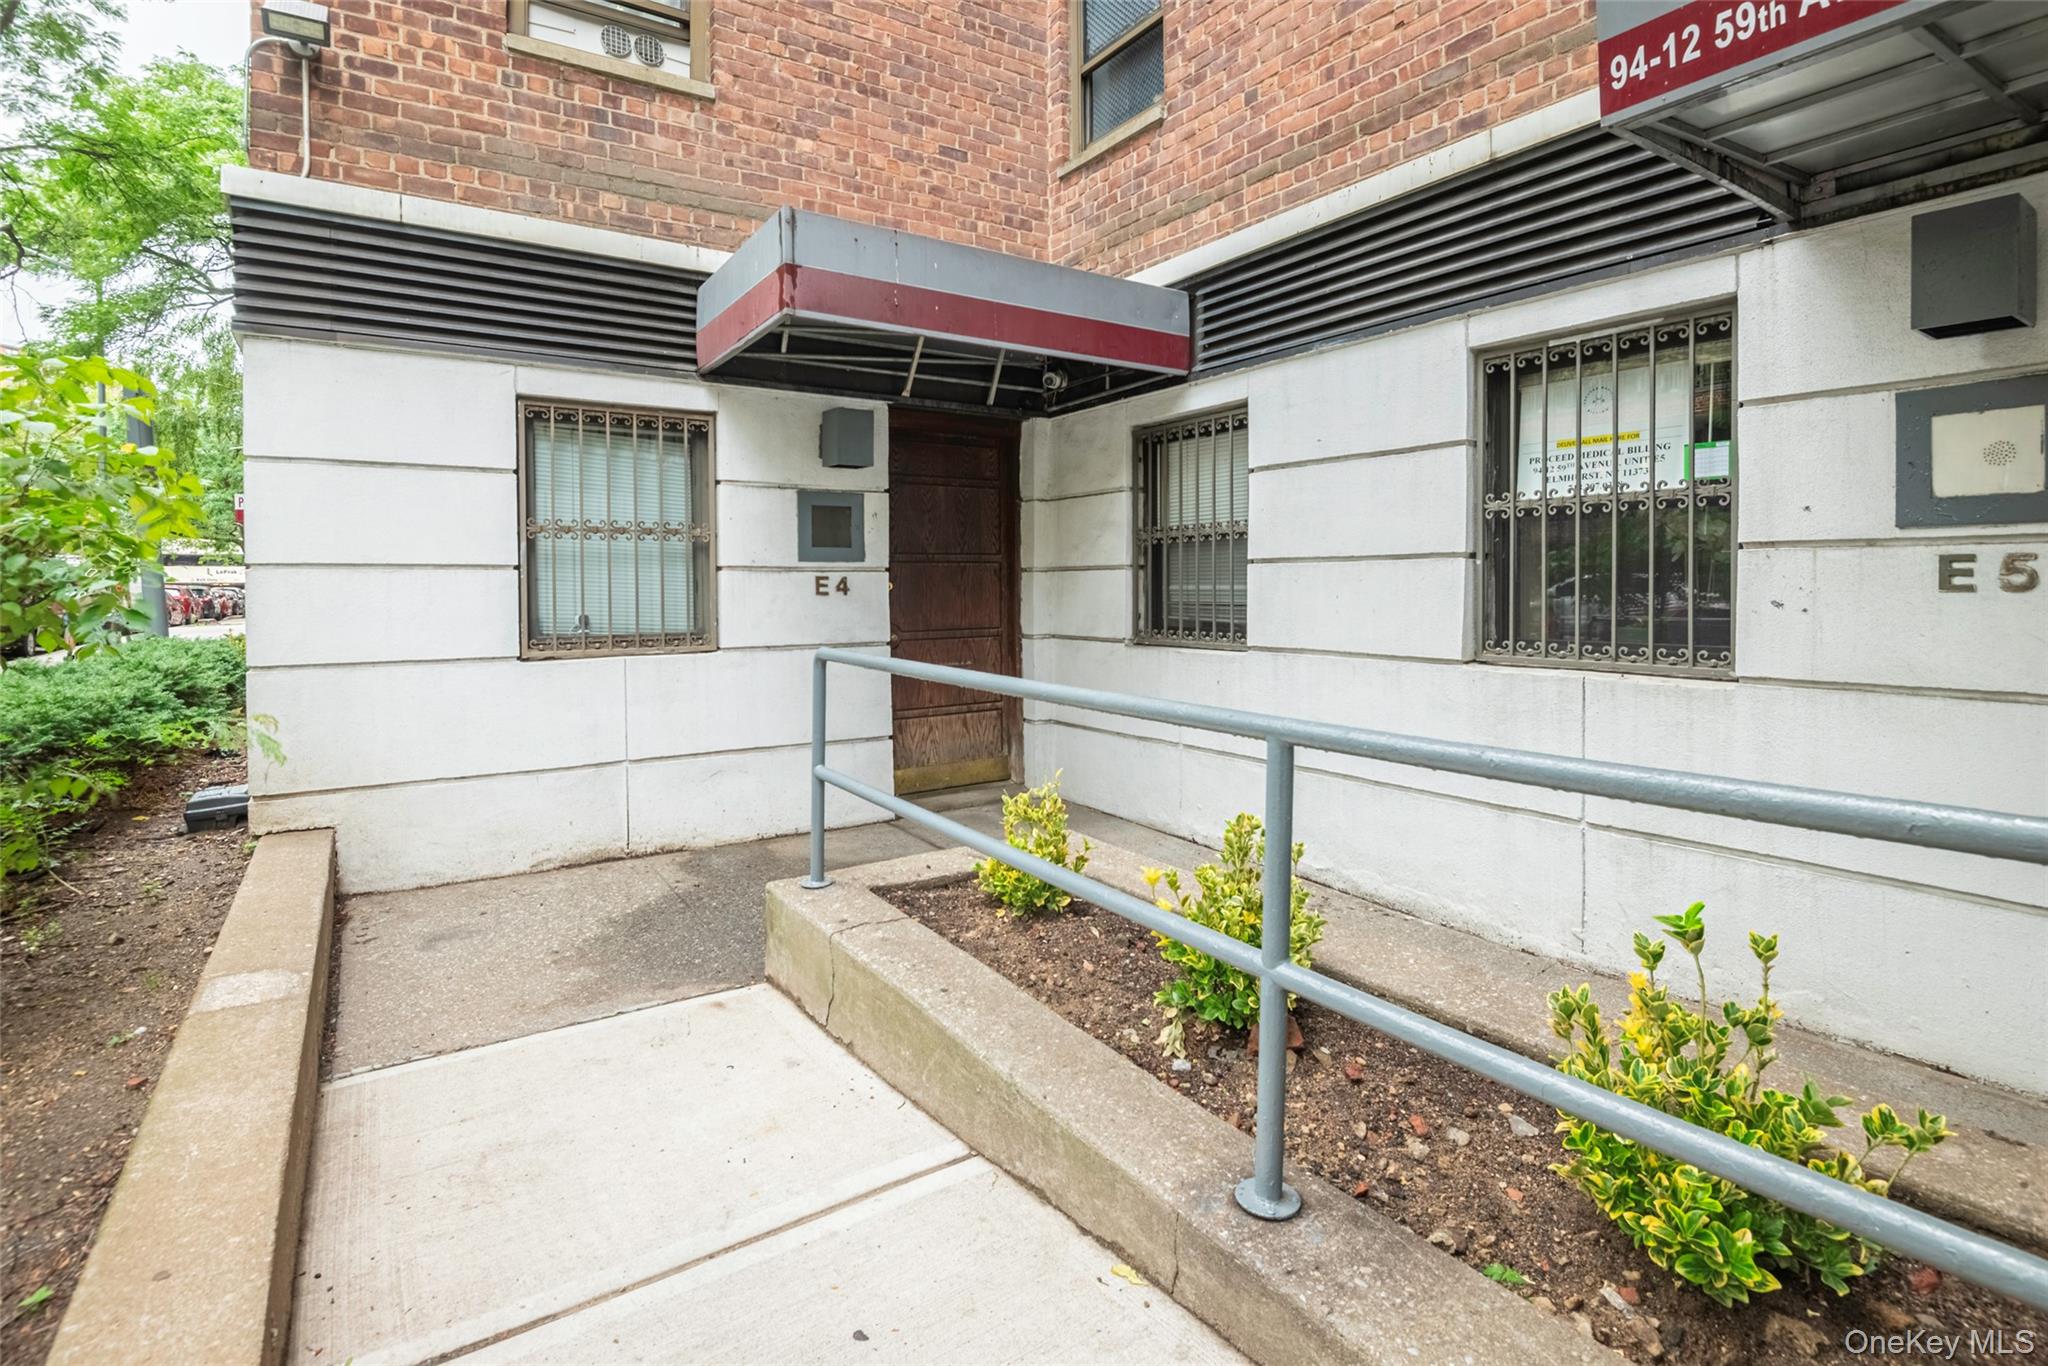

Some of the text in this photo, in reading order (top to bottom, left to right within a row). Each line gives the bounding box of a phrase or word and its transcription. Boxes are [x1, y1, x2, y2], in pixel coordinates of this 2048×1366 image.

[1610, 0, 1788, 91] 94-12 59th
[1626, 432, 1640, 441] FOR
[1623, 467, 1649, 477] 11373
